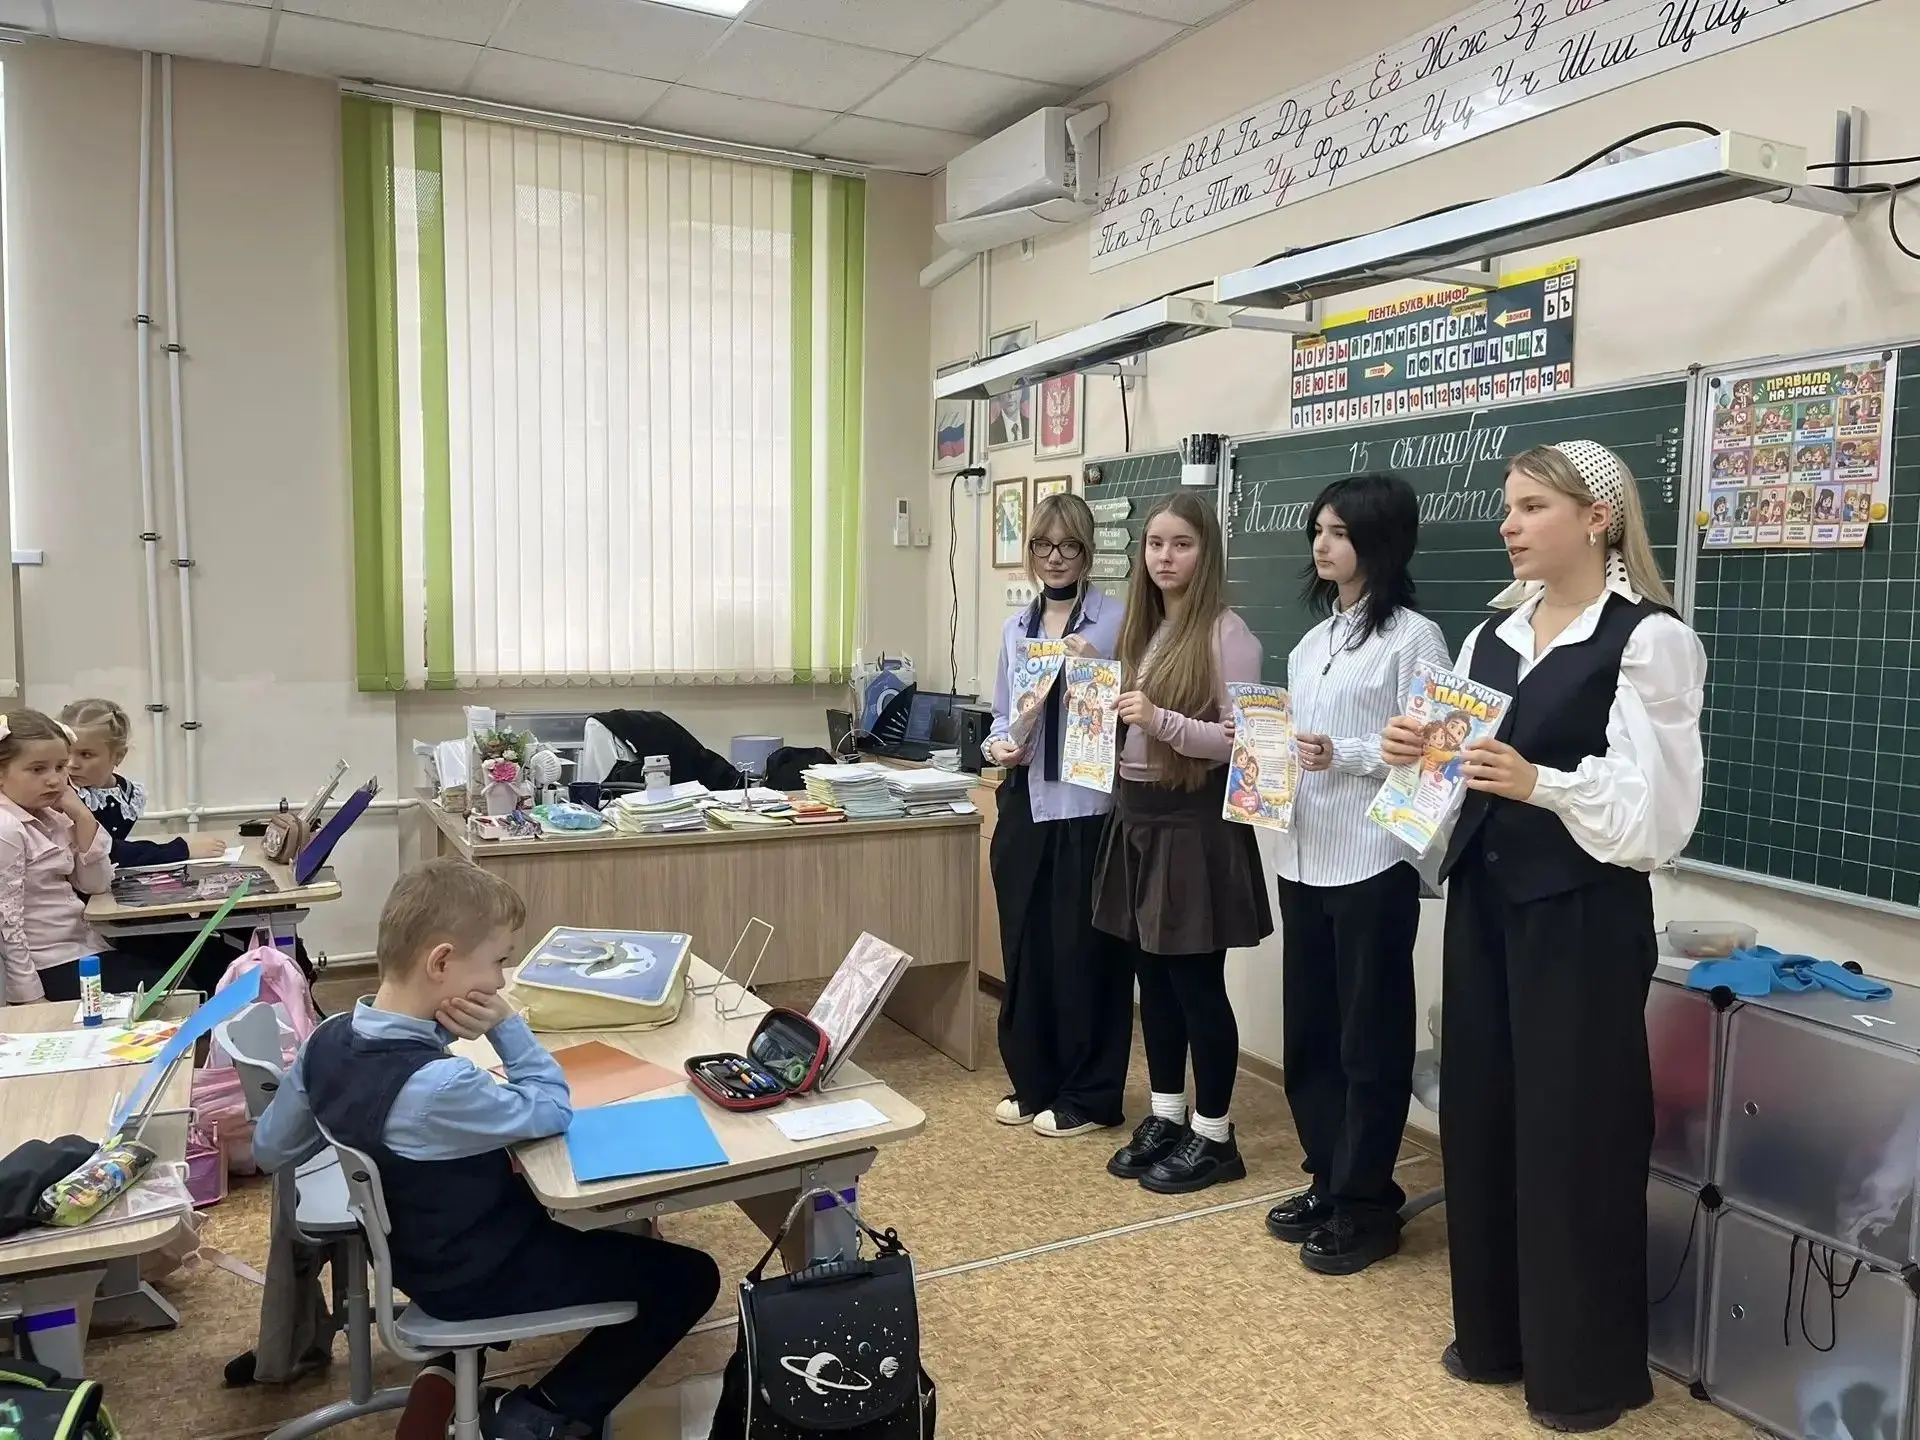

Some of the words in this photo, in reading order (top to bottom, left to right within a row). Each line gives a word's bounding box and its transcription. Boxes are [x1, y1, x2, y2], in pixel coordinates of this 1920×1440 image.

[1367, 304, 1397, 322] ЛЕНТА
[1400, 296, 1424, 313] БУКВ
[1437, 287, 1469, 307] ЦИФР
[1766, 371, 1831, 391] ПРАВИЛА
[1769, 390, 1785, 402] НА
[1788, 385, 1827, 398] УРОКЕ
[1350, 441, 1369, 473] 15
[1390, 410, 1508, 487] октября
[1245, 481, 1314, 532] Класс
[1416, 465, 1504, 524] абота
[1431, 672, 1465, 693] ЧЕМУ
[1467, 683, 1501, 706] УЧИТ
[1434, 686, 1488, 720] ПАПА
